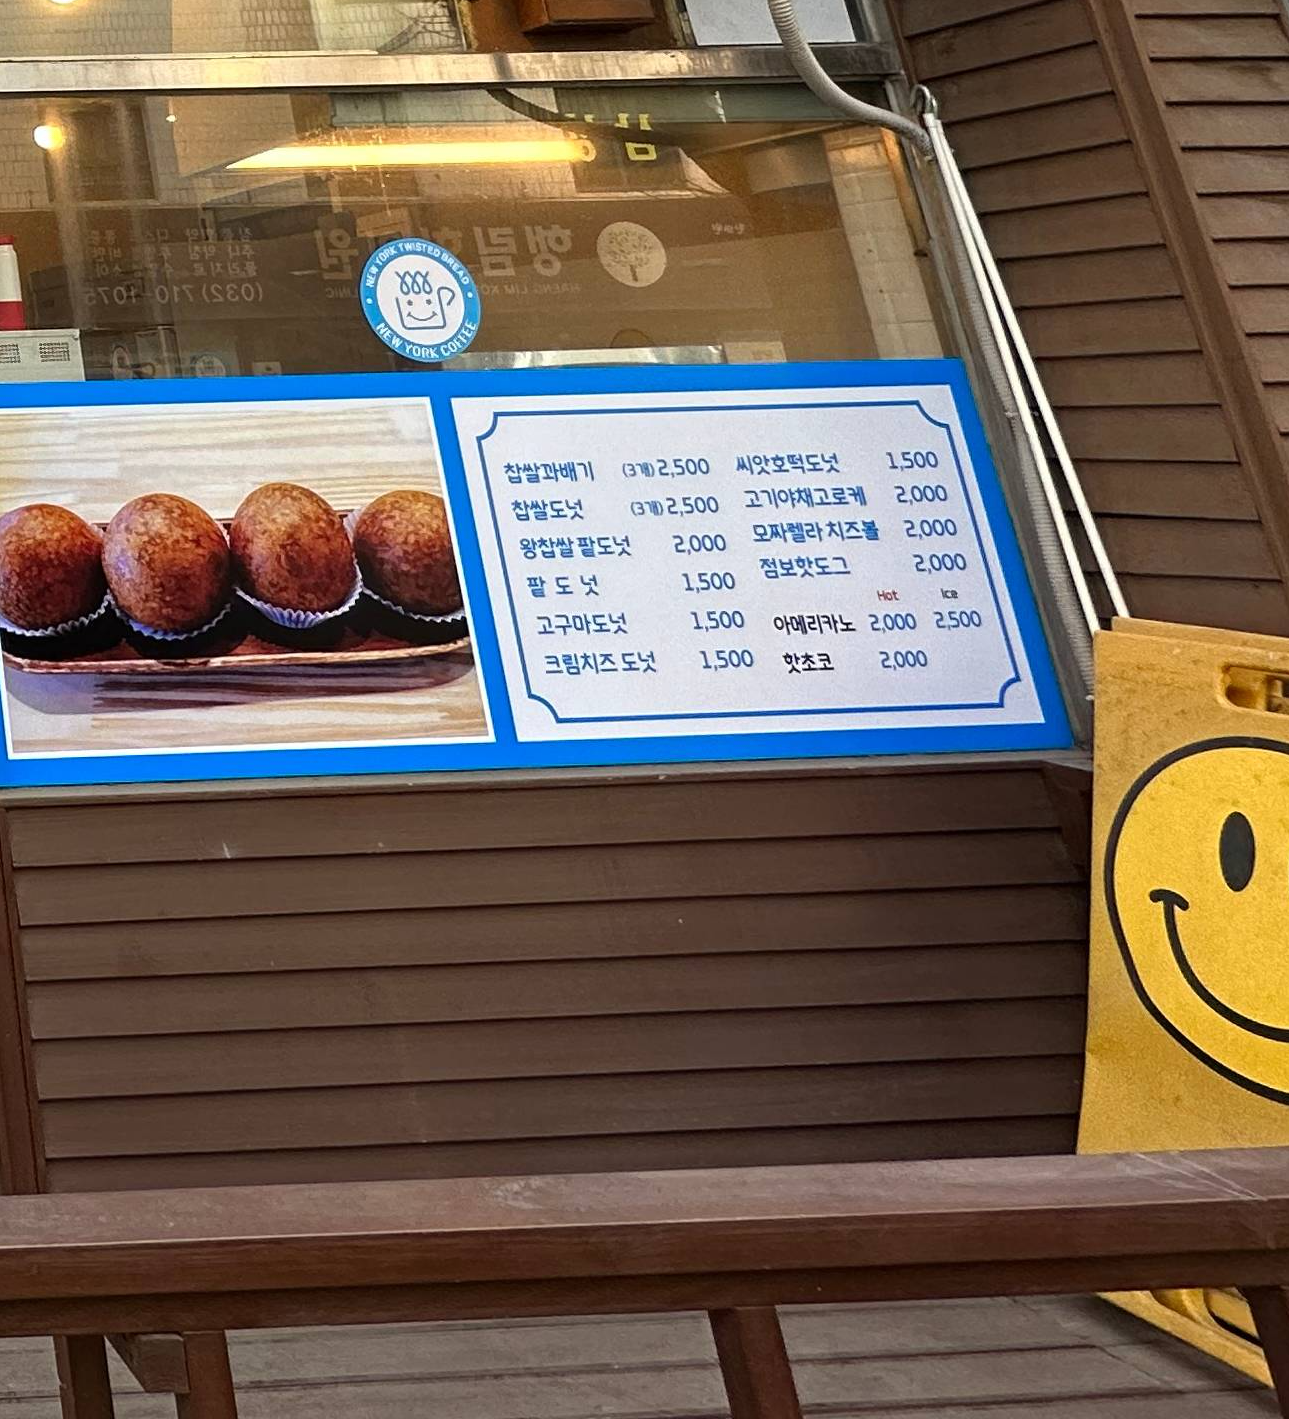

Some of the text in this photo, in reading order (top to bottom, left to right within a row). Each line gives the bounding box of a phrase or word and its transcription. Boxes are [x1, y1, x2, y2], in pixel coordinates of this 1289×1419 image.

[365, 242, 470, 288] NEW YORK TWISTED BREAD
[375, 318, 477, 359] NEW YORK COFFEE
[503, 460, 595, 484] 찹쌀꽈배기
[657, 458, 710, 478] 2,500
[736, 451, 939, 476] 씨앗호떡도넛 1,500
[511, 498, 585, 521] 찹쌀도넛
[666, 496, 719, 516] 2,500
[744, 485, 949, 508] 고기야채고로케 2,000
[752, 518, 958, 543] 모짜렐라 치즈볼 2,000
[672, 533, 727, 556] 2,000
[760, 553, 968, 579] 점보핫도그 2,000
[681, 572, 736, 593] 1,500
[877, 588, 959, 602] Hot Ice
[536, 610, 745, 636] 고구마도넛 1,500
[772, 610, 982, 636] 아메리카노 2,000 2,500
[699, 649, 754, 671] 1,500
[782, 650, 928, 675] 핫초코 2,000
